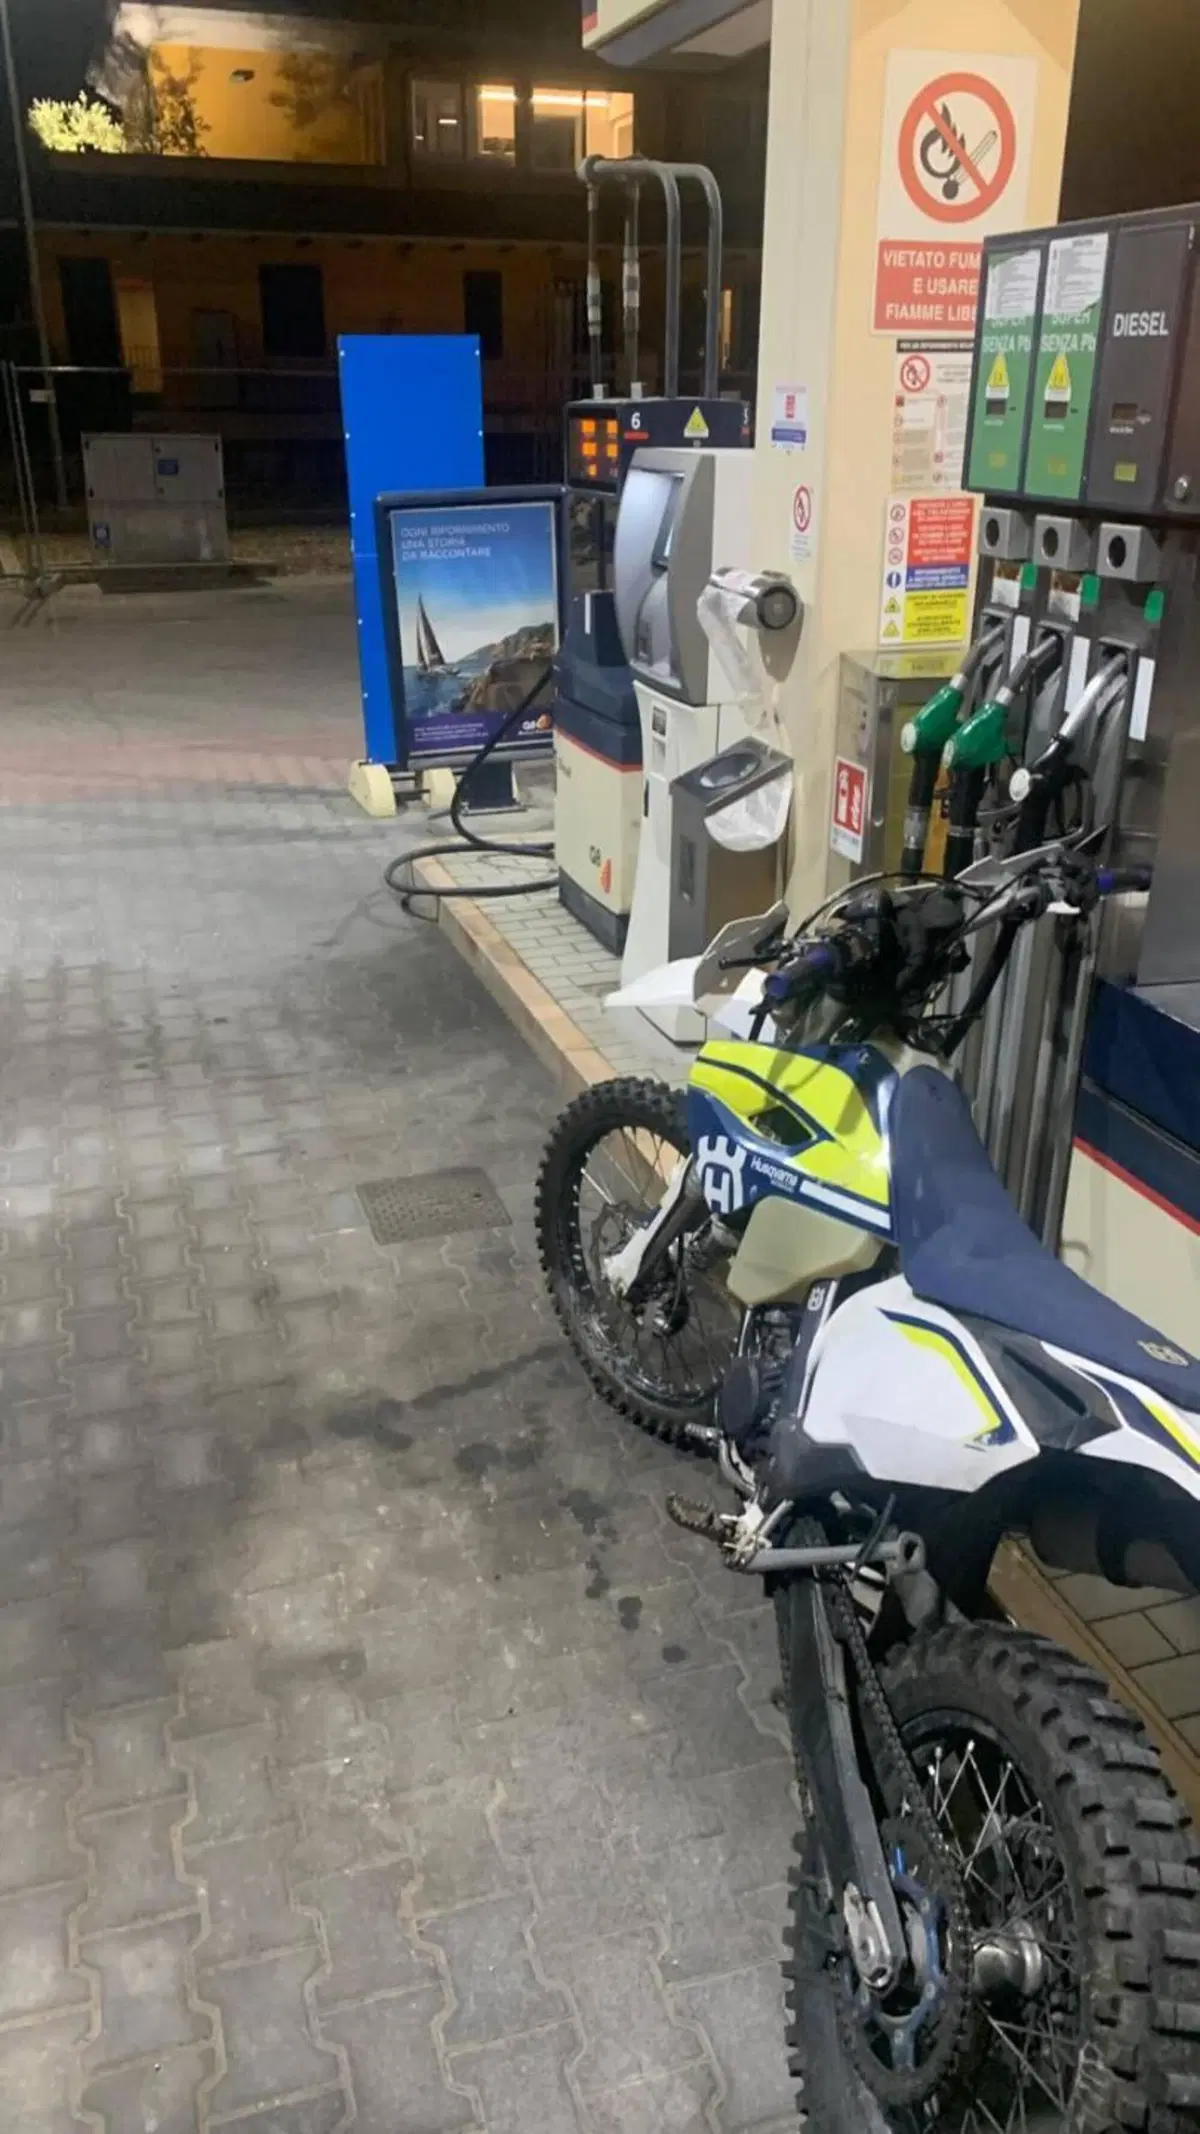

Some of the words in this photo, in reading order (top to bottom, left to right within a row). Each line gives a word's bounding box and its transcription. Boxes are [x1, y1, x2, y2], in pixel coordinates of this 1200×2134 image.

[884, 248, 945, 269] VIETATO
[912, 277, 923, 294] E
[927, 277, 978, 296] USARE
[886, 303, 945, 321] FIAMME
[1113, 311, 1169, 337] DIESEL
[981, 334, 1015, 352] SENZA
[1041, 333, 1078, 352] SENZA
[631, 411, 641, 430] 6
